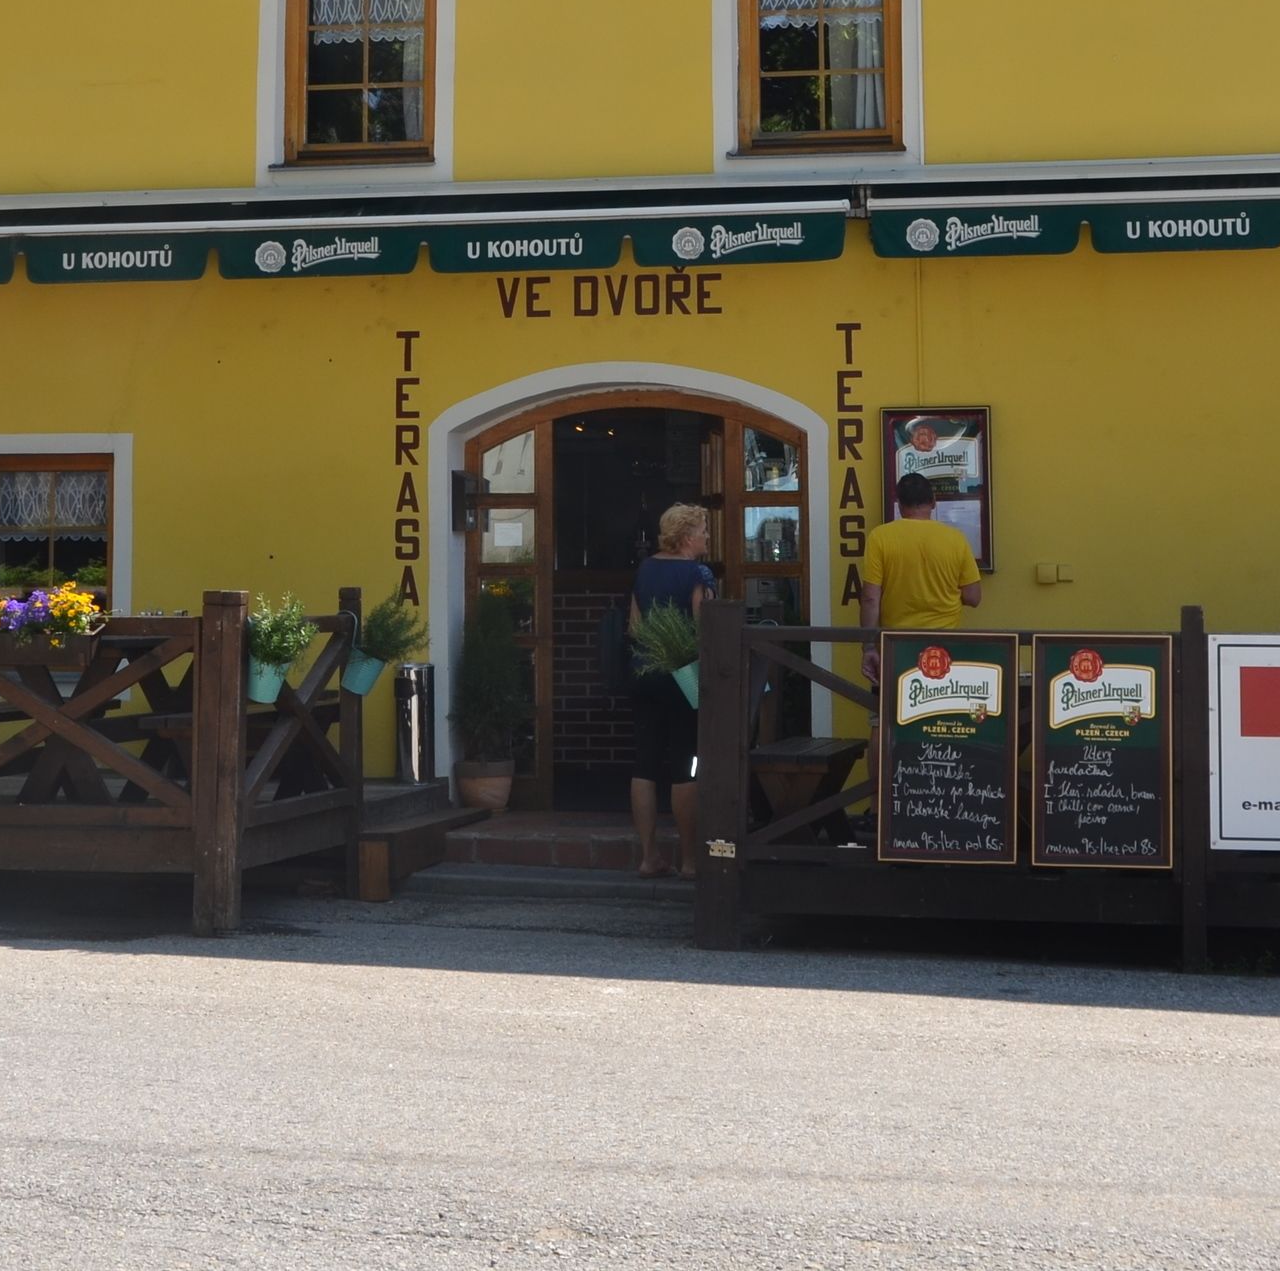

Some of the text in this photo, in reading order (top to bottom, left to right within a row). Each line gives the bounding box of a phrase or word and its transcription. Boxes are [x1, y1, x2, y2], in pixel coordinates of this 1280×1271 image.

[710, 222, 802, 259] Pilsner Urquell
[945, 214, 1039, 251] Pilsner Urquell
[1126, 212, 1250, 239] U KOHOUTŮ
[62, 244, 172, 270] U KOHOUTŮ
[291, 236, 379, 272] Pilsner Urquell
[467, 232, 583, 259] U KOHOUTŮ
[496, 266, 723, 319] VE DVOŘE
[394, 329, 421, 607] TERASA
[835, 322, 866, 607] TERASA
[904, 450, 969, 473] Pilsner Urquell
[908, 678, 989, 708] Pilsner Urquell
[1060, 681, 1142, 712] Pilsner Urquell
